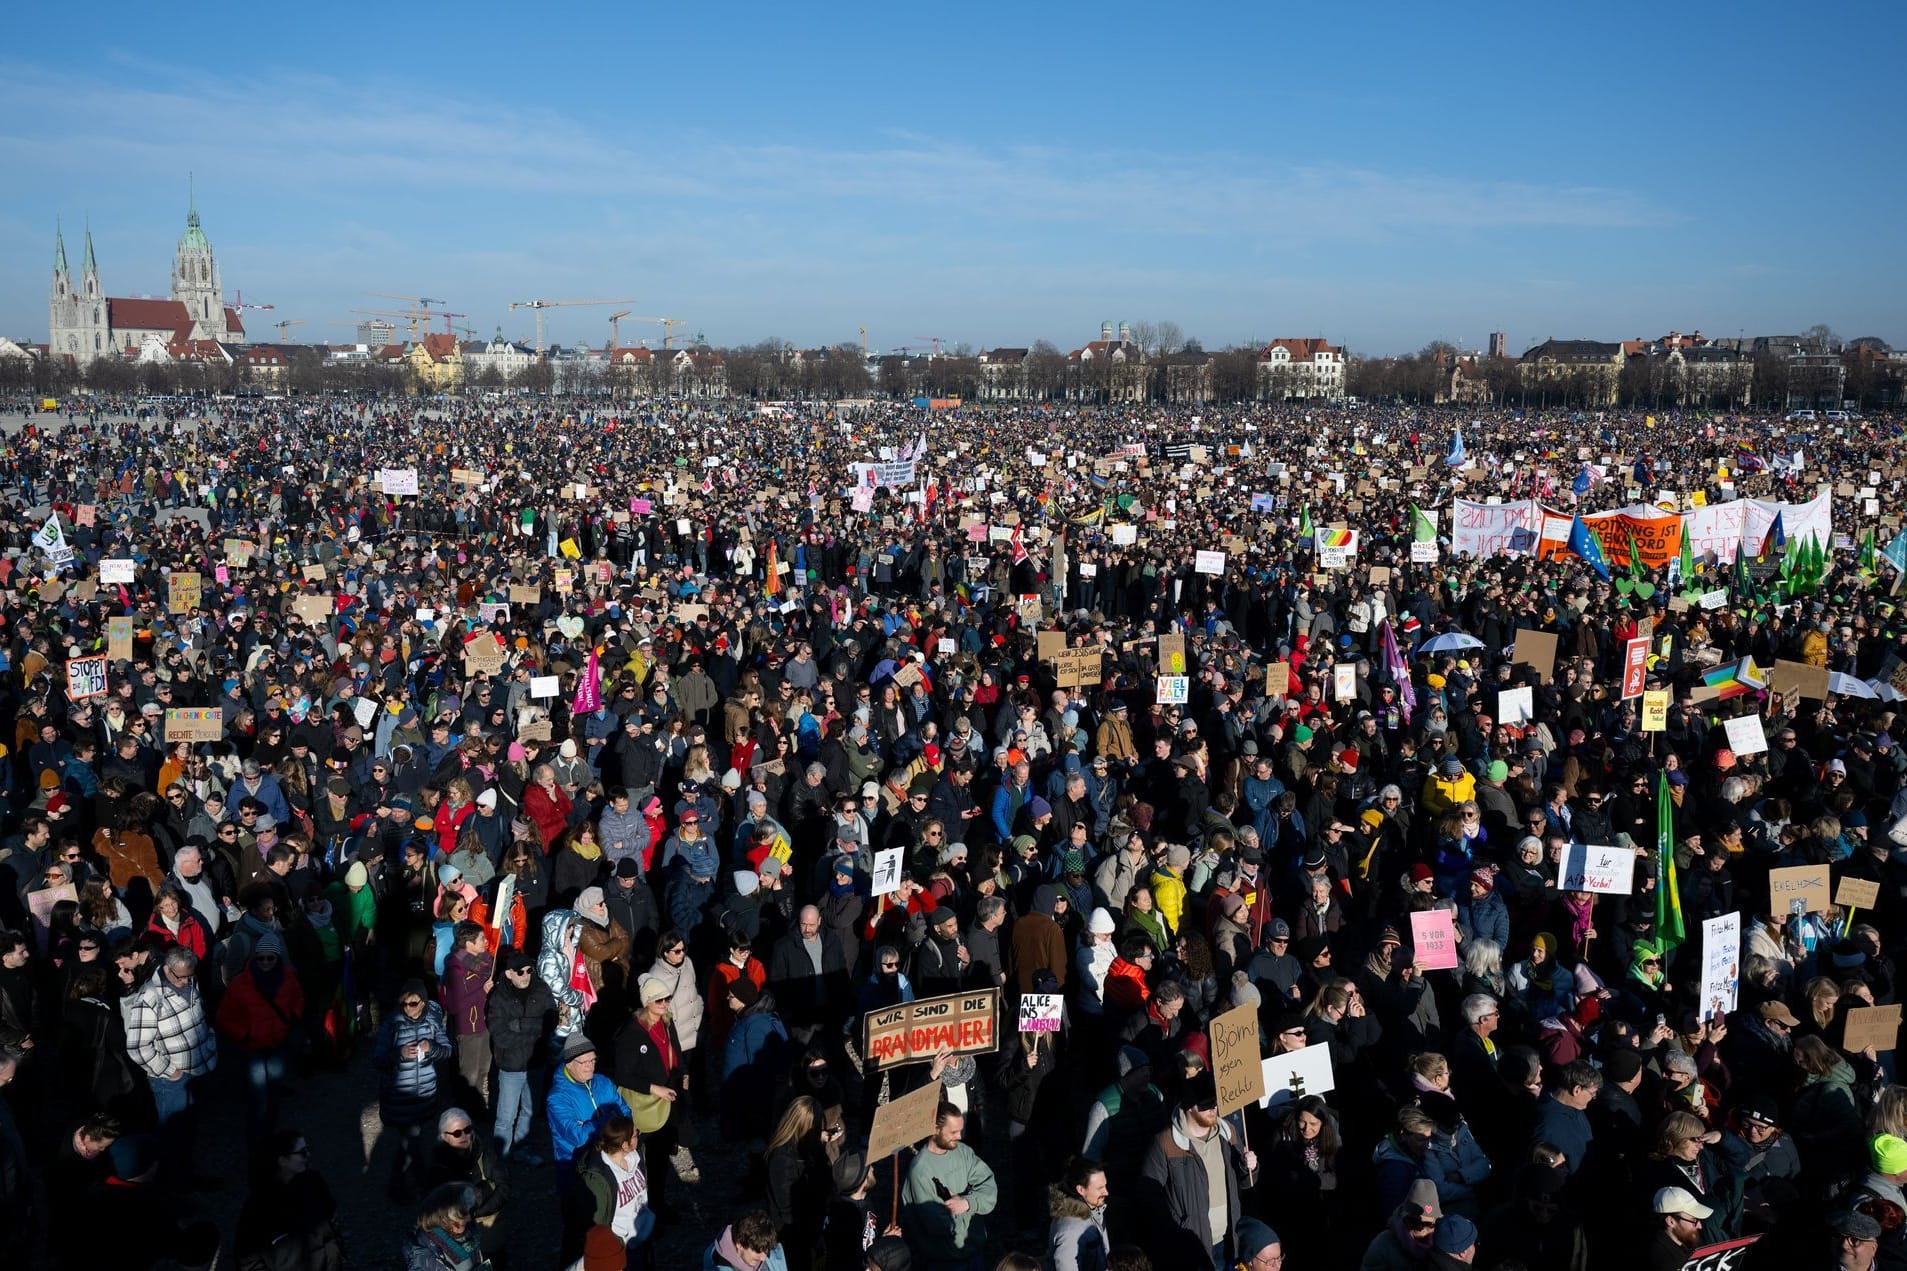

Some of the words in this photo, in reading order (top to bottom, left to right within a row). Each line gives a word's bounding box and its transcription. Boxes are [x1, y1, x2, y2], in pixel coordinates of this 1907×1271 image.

[1660, 524, 1677, 538] IST
[70, 659, 105, 678] STOPPT
[1160, 679, 1185, 688] VIEL
[1159, 689, 1186, 698] FALT
[168, 731, 193, 740] RECHTE
[1564, 875, 1613, 889] AfD-Verbot
[1426, 941, 1444, 951] 1933
[1021, 995, 1051, 1008] ALICE
[876, 1012, 905, 1025] WIR
[912, 1003, 949, 1018] SIND
[962, 997, 986, 1012] DIE
[1020, 1007, 1038, 1019] INS
[871, 1017, 994, 1060] BRANDMAUER!
[1214, 1020, 1256, 1058] Björns
[1219, 1058, 1243, 1080] gegen
